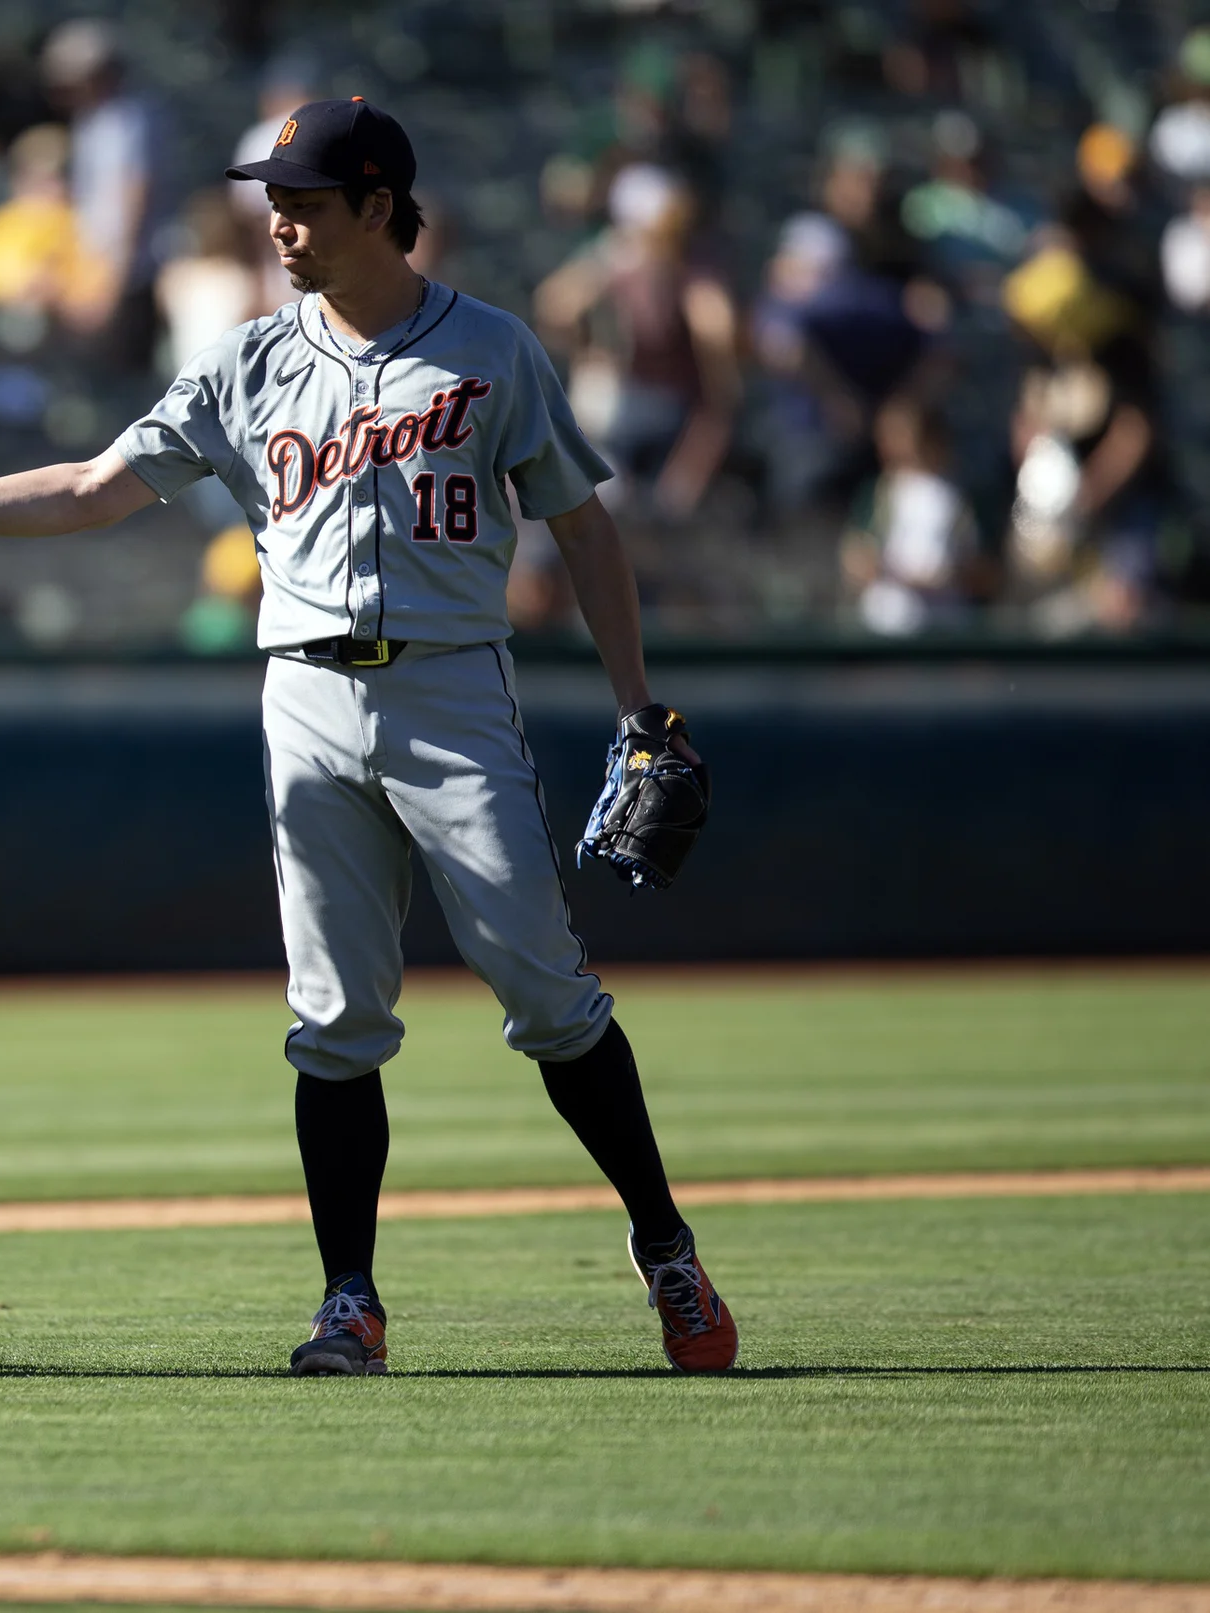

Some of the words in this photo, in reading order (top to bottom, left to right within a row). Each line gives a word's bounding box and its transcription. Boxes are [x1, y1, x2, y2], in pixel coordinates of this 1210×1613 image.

[275, 117, 299, 147] D
[267, 377, 492, 524] Detroit
[412, 472, 477, 543] 18
